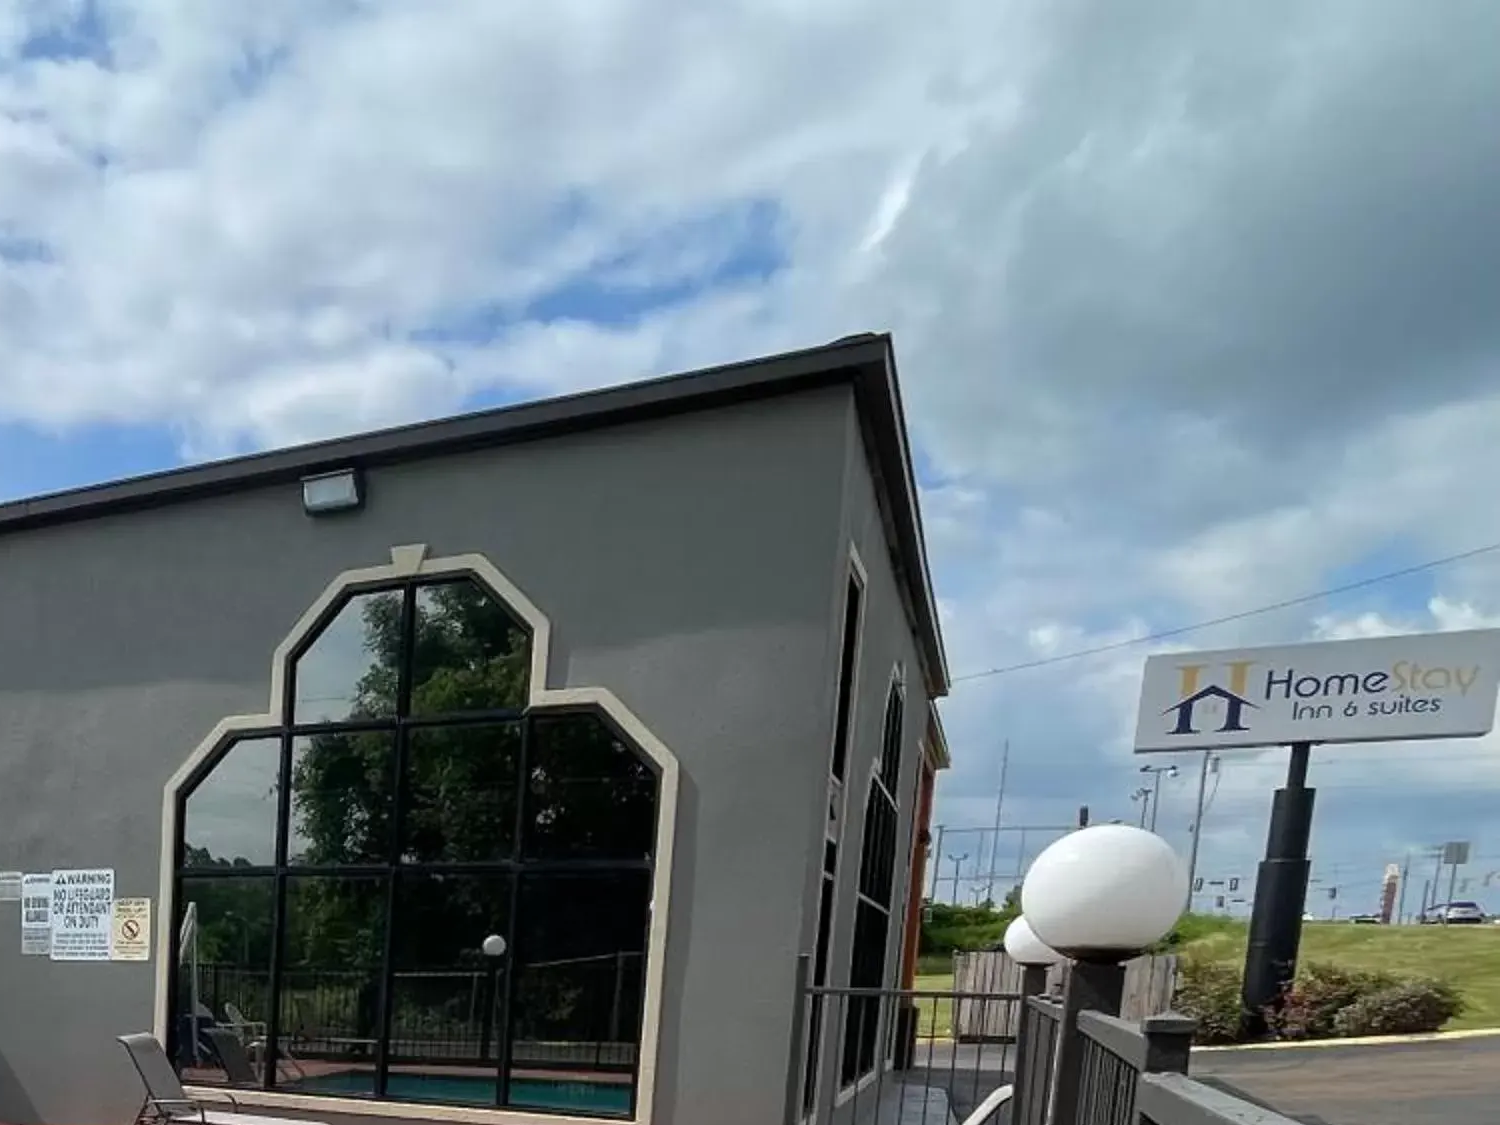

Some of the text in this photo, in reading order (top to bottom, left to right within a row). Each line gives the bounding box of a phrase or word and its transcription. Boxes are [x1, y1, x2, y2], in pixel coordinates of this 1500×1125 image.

[1264, 660, 1480, 700] HomeStay
[1291, 701, 1333, 720] Inn
[1367, 694, 1442, 716] suites
[67, 873, 112, 884] WARNING
[53, 887, 111, 901] NO LIFEGUARD
[63, 916, 77, 929] ON
[78, 915, 100, 928] DUTY
